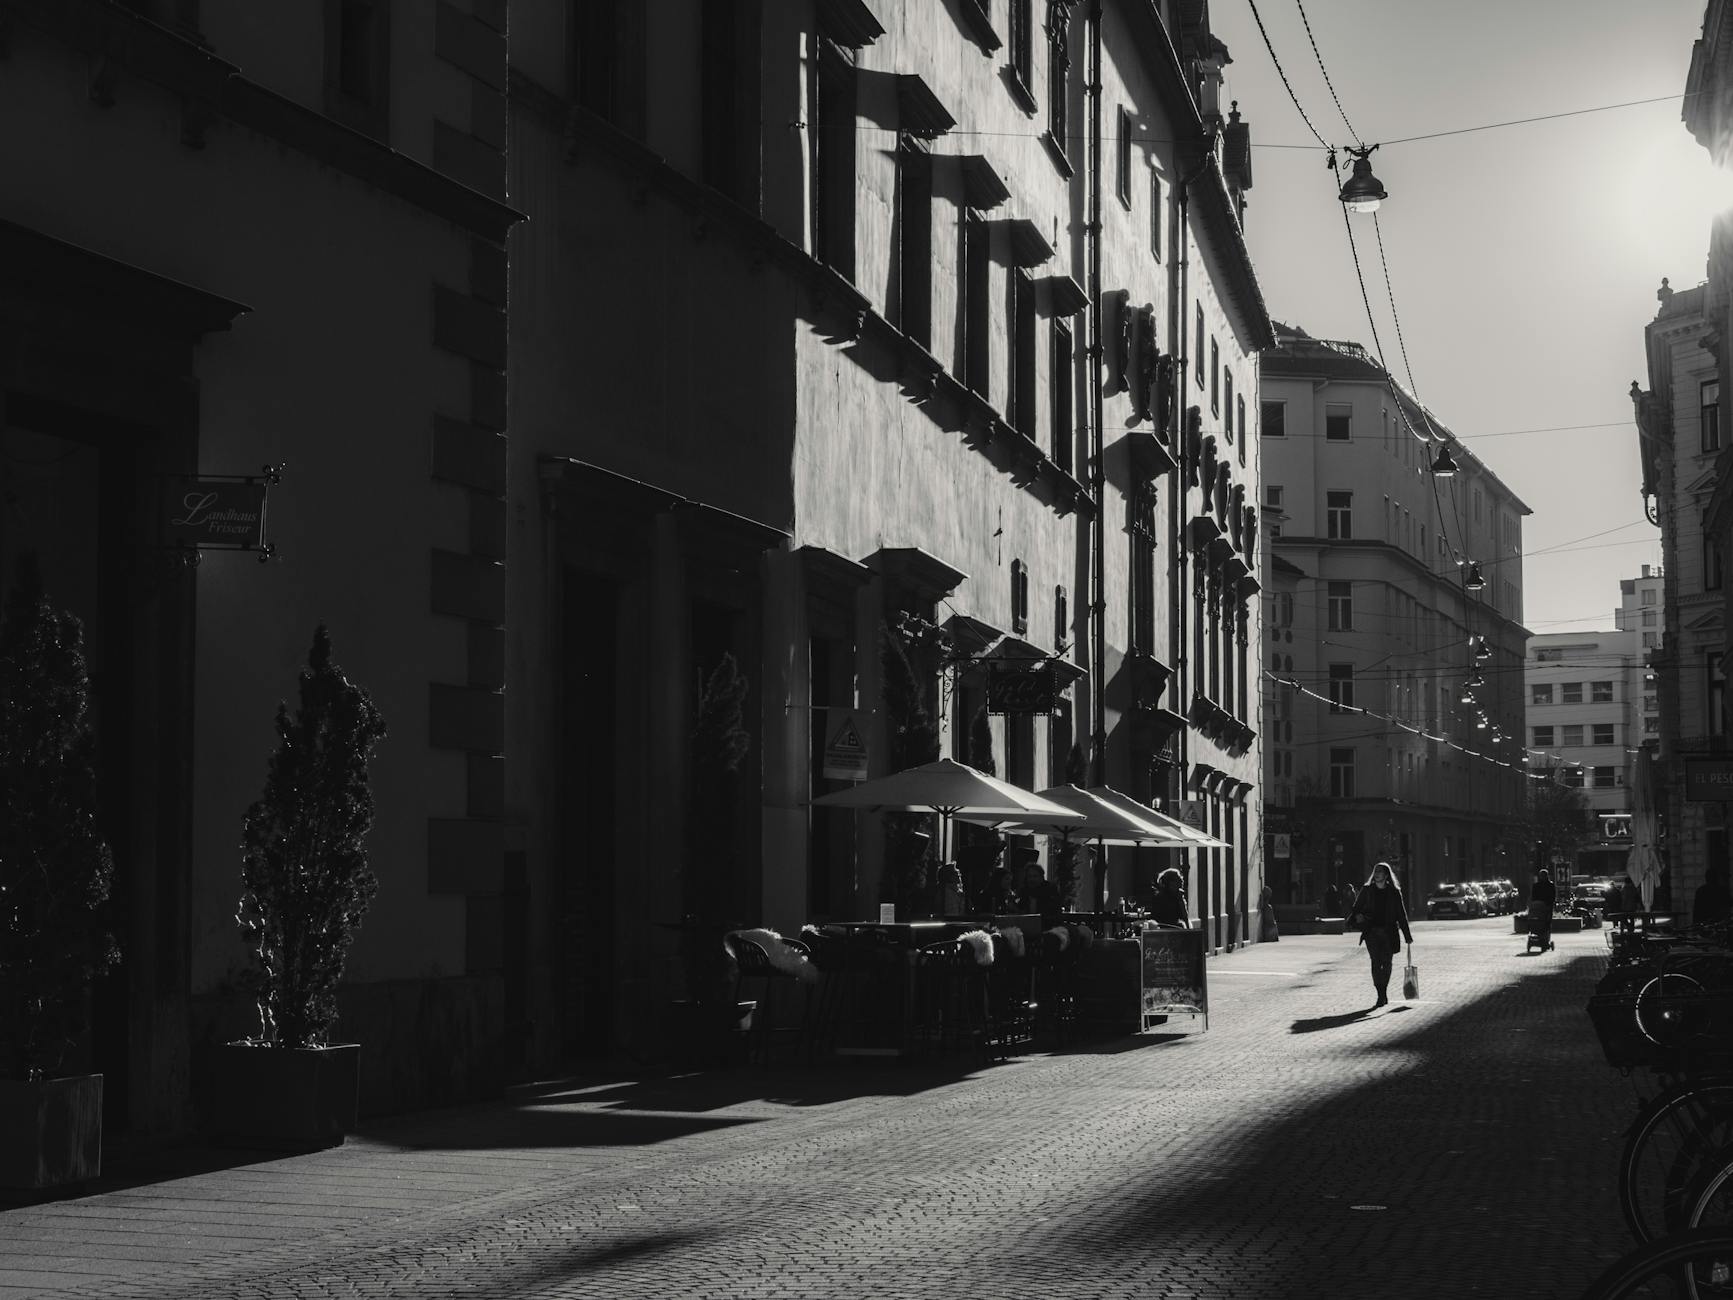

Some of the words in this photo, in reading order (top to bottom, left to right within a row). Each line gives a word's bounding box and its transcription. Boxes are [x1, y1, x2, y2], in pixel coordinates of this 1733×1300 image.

[171, 491, 258, 526] Landhaus
[208, 521, 252, 534] Friseur
[1695, 772, 1706, 784] EL
